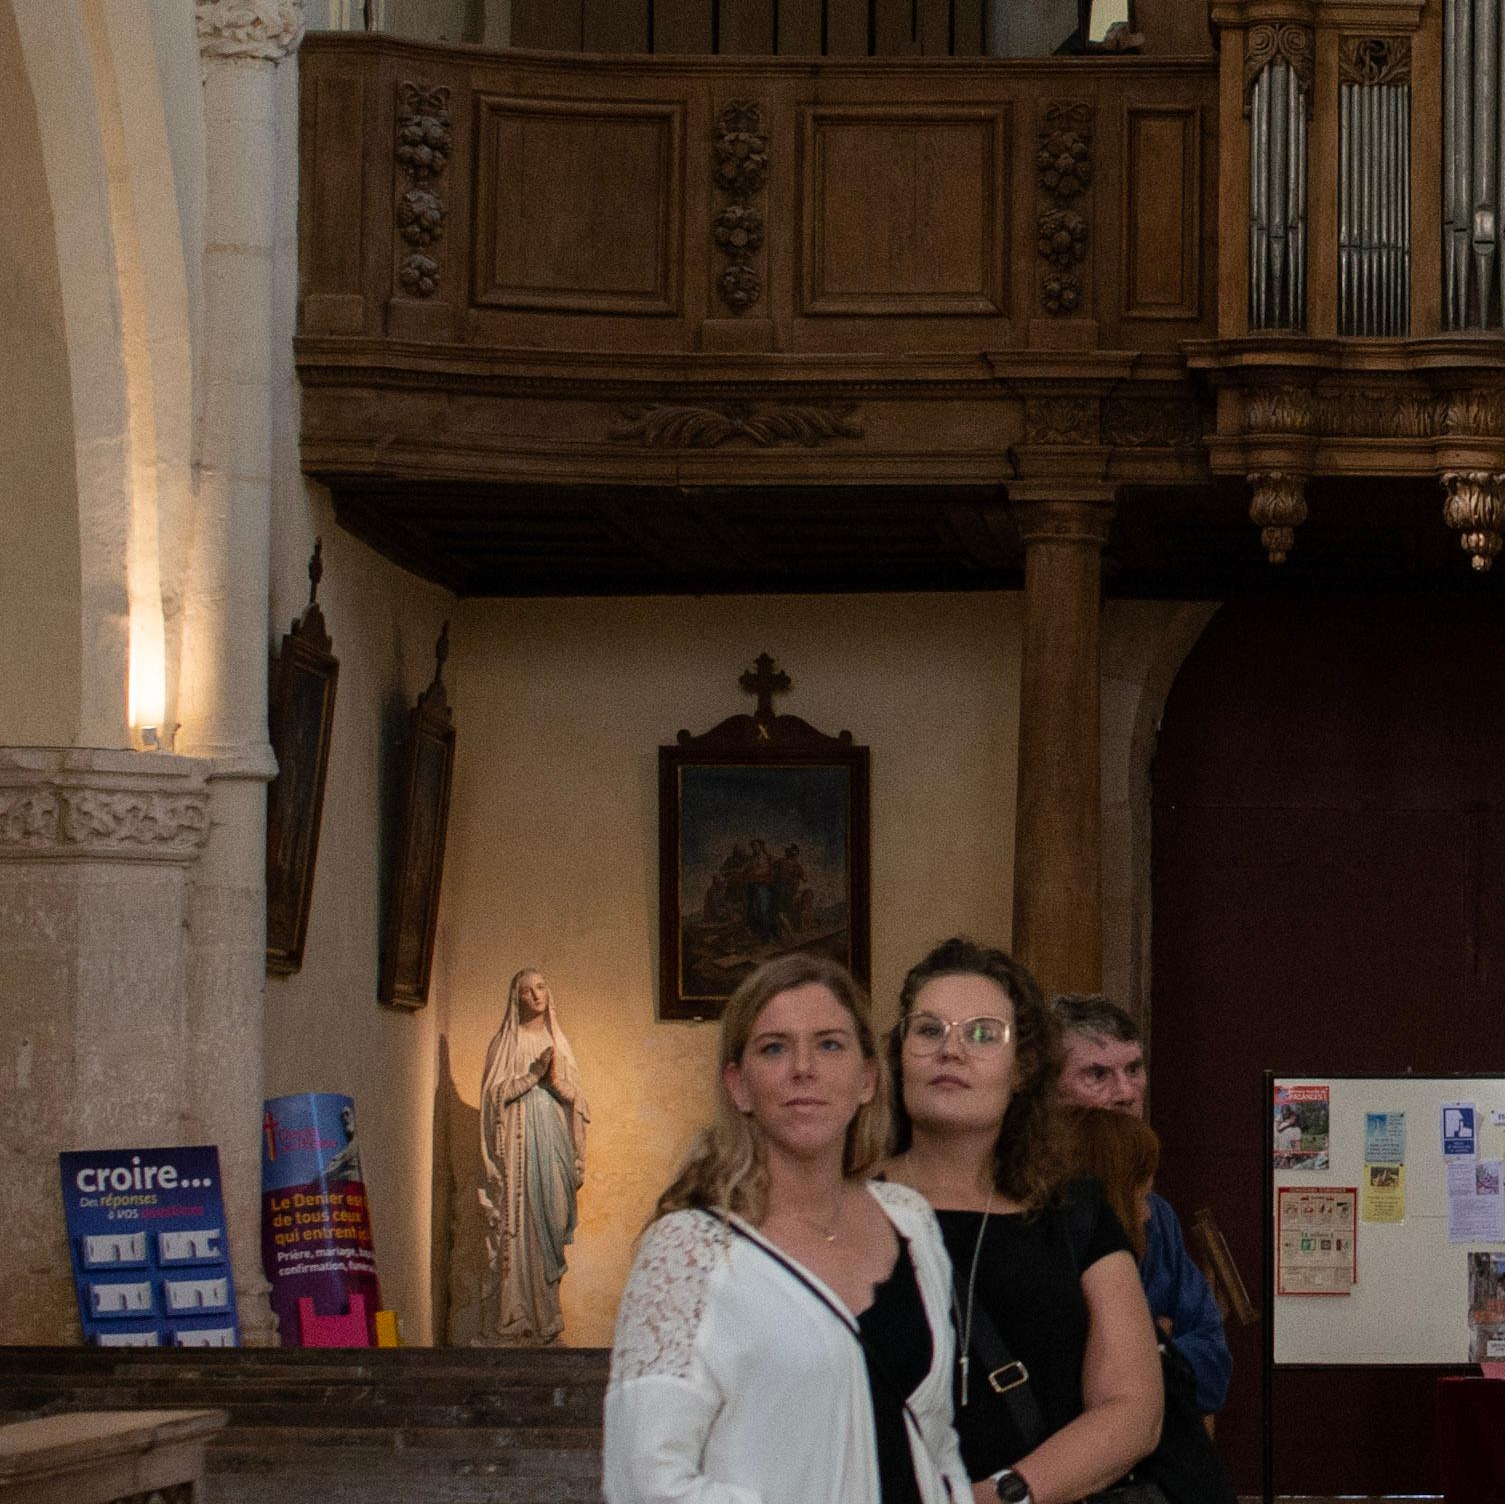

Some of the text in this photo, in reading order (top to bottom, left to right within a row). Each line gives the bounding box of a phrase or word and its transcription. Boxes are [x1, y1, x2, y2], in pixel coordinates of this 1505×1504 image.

[757, 724, 771, 740] X
[76, 1155, 212, 1193] croire...
[100, 1192, 158, 1209] réponses
[271, 1197, 290, 1211] Le
[294, 1193, 343, 1207] Denier
[117, 1208, 139, 1219] vos
[273, 1214, 292, 1228] de
[295, 1210, 330, 1224] tous
[275, 1228, 300, 1246] qui
[303, 1225, 356, 1241] entrent
[277, 1248, 314, 1262] Prière,
[278, 1261, 348, 1276] confirmation,
